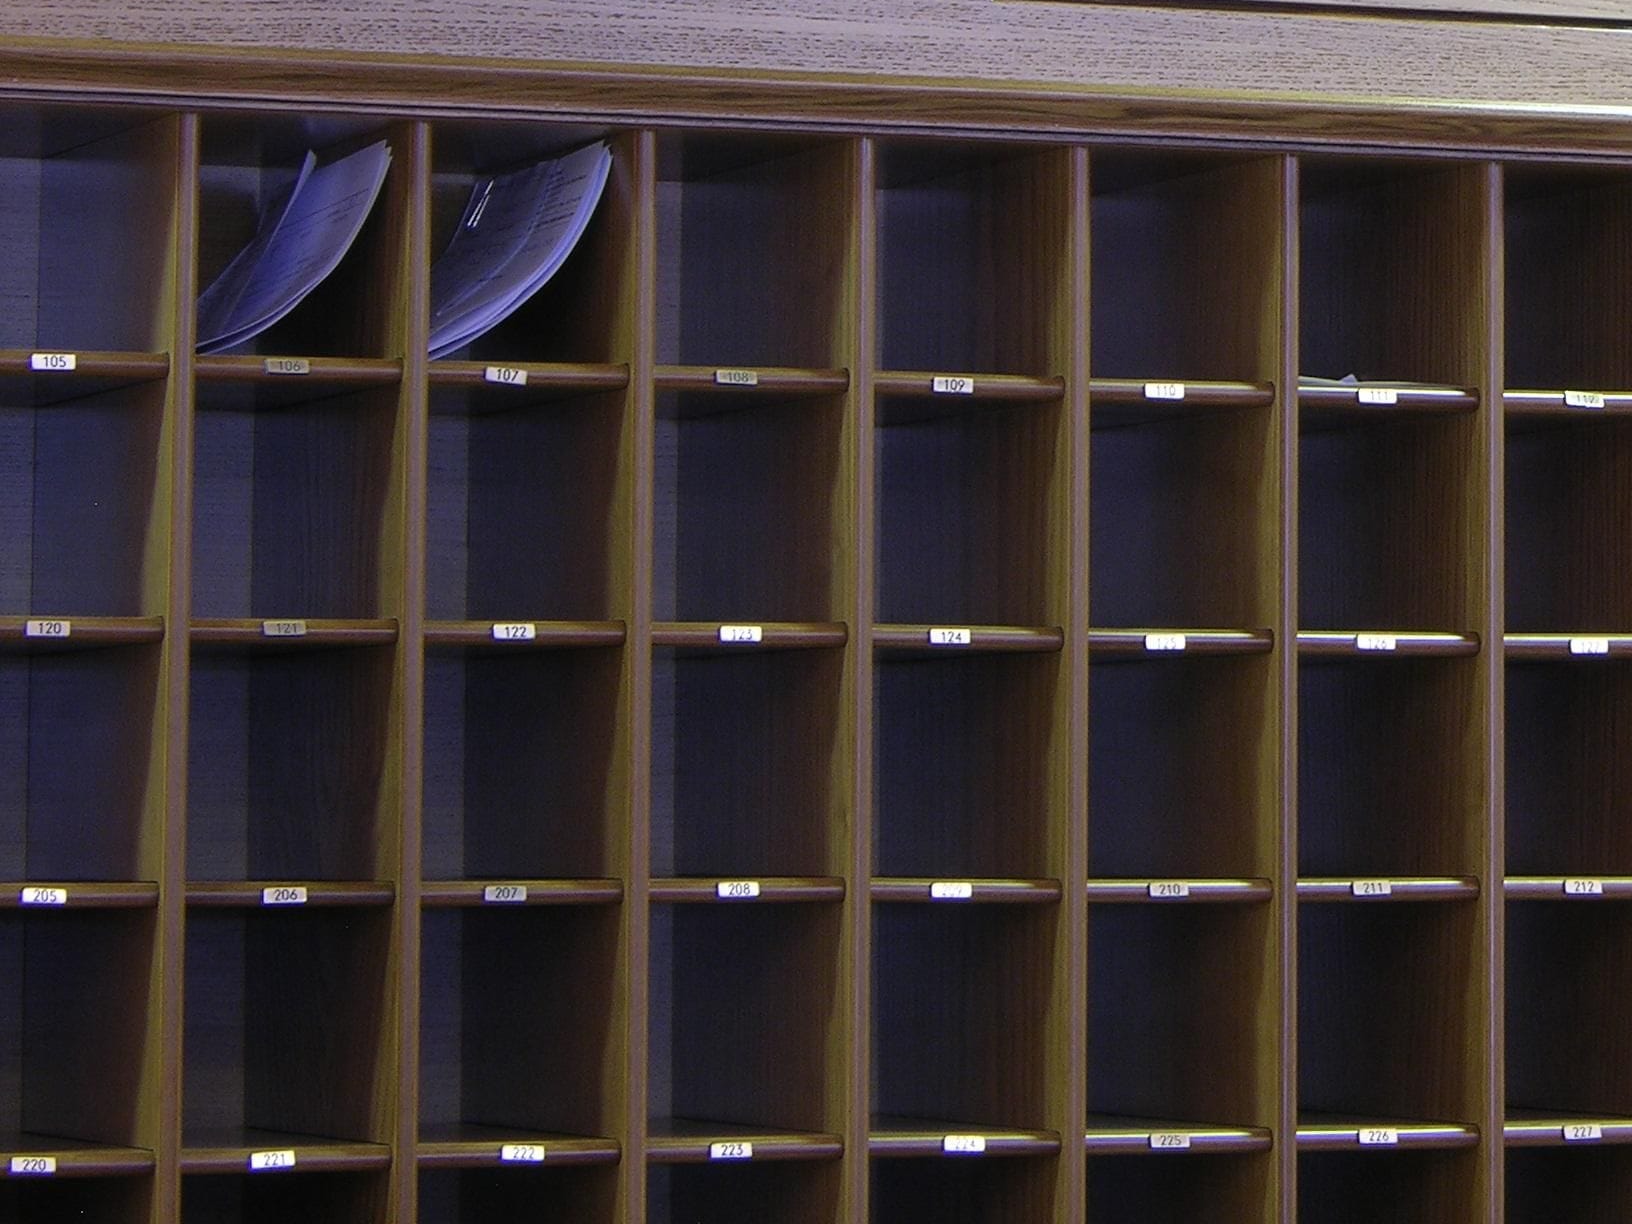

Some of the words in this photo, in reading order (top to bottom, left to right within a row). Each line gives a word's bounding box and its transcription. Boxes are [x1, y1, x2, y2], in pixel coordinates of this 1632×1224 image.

[42, 356, 67, 368] 105
[278, 360, 301, 372] 106
[496, 369, 519, 382] 107
[727, 371, 749, 382] 108
[944, 379, 965, 391] 109
[38, 622, 61, 634] 120
[276, 623, 297, 634] 121
[504, 626, 527, 638] 122
[941, 631, 962, 643] 124
[728, 883, 750, 896] 208
[1159, 883, 1181, 895] 210
[1363, 883, 1384, 894] 211
[1574, 880, 1594, 892] 212
[33, 890, 57, 902] 205
[274, 889, 298, 902] 206
[495, 887, 517, 899] 207
[1368, 1131, 1389, 1142] 226
[1572, 1126, 1593, 1138] 227
[1160, 1135, 1181, 1147] 225
[513, 1146, 535, 1159] 222
[721, 1144, 744, 1156] 223
[22, 1158, 47, 1172] 220
[264, 1153, 286, 1166] 221
